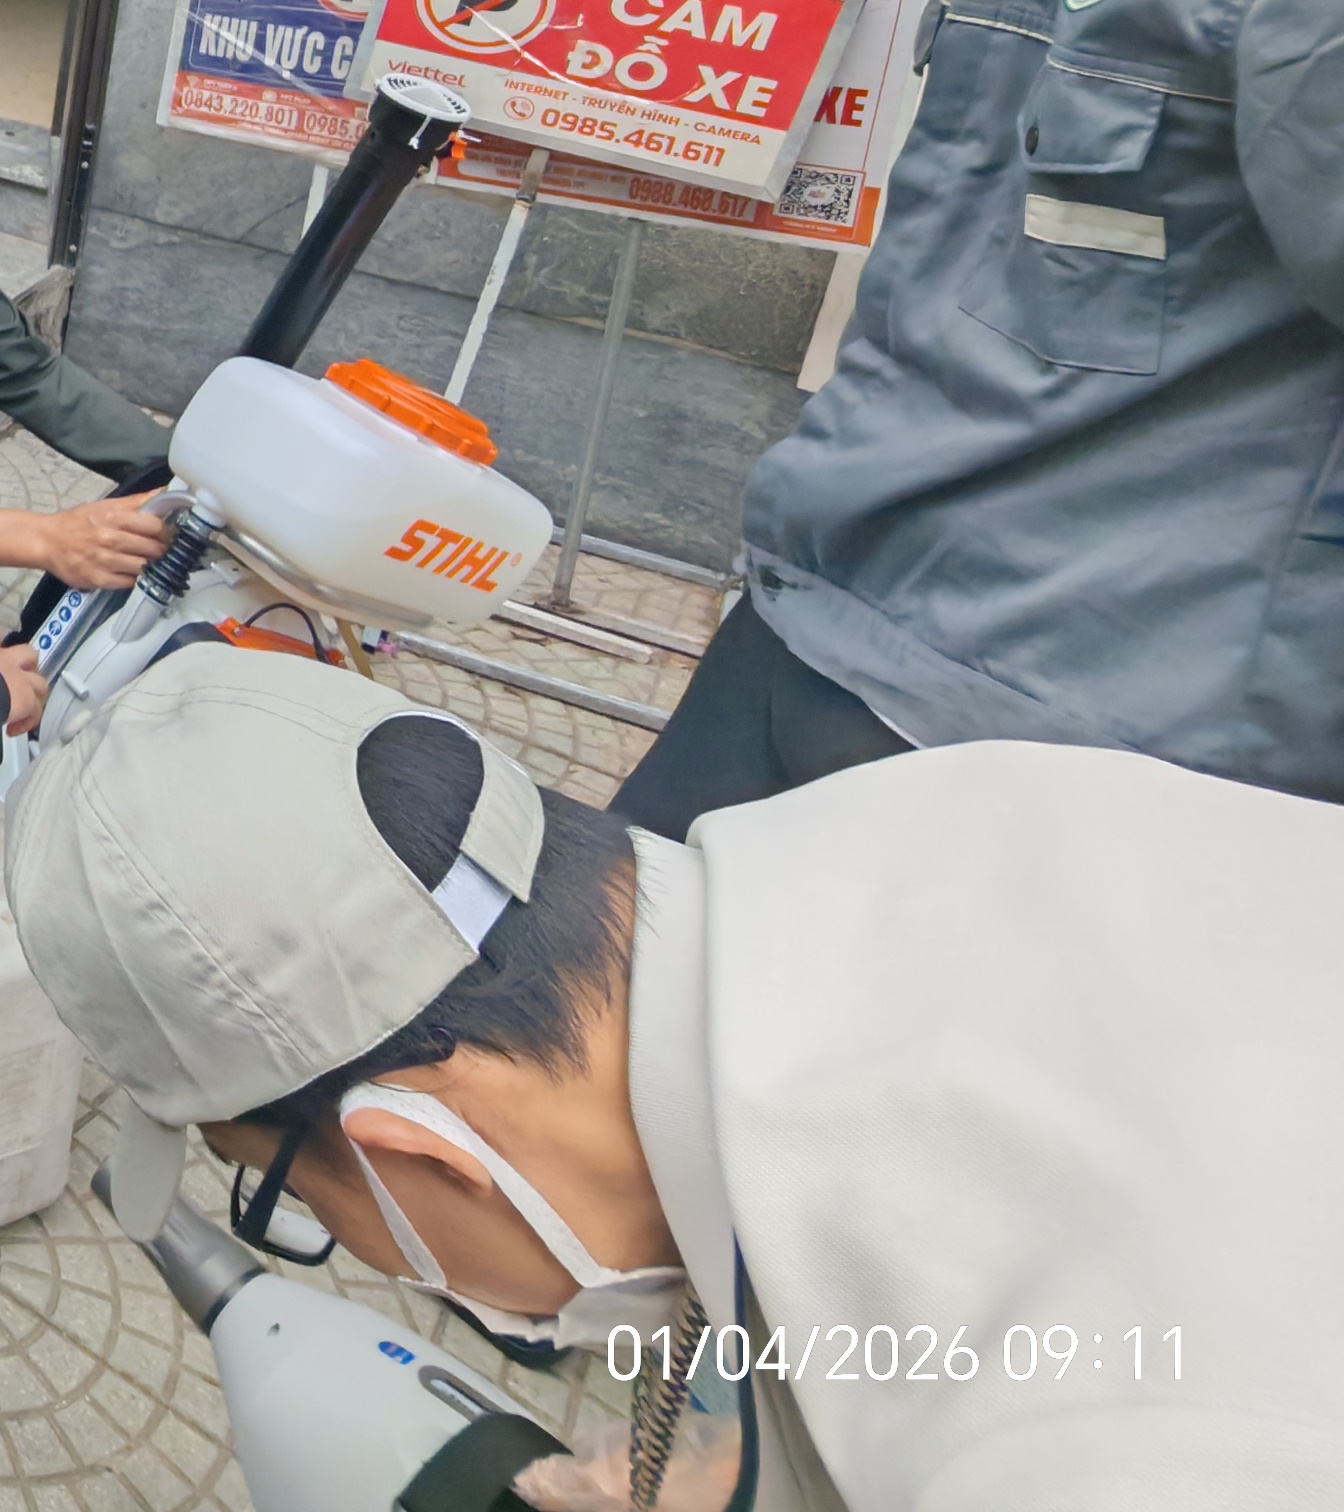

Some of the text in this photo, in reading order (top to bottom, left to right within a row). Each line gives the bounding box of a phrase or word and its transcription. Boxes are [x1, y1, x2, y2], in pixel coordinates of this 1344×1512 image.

[198, 13, 258, 62] KHU
[265, 23, 325, 79] VỰC
[387, 59, 467, 88] viettel
[566, 35, 779, 118] ĐỖ XE
[183, 89, 295, 128] 0843.220.801
[504, 79, 569, 102] INTERNET
[581, 95, 637, 118] TRUYỀN
[693, 121, 761, 145] CAMERA
[540, 108, 725, 167] 0985.461.611
[383, 519, 510, 593] STIHL
